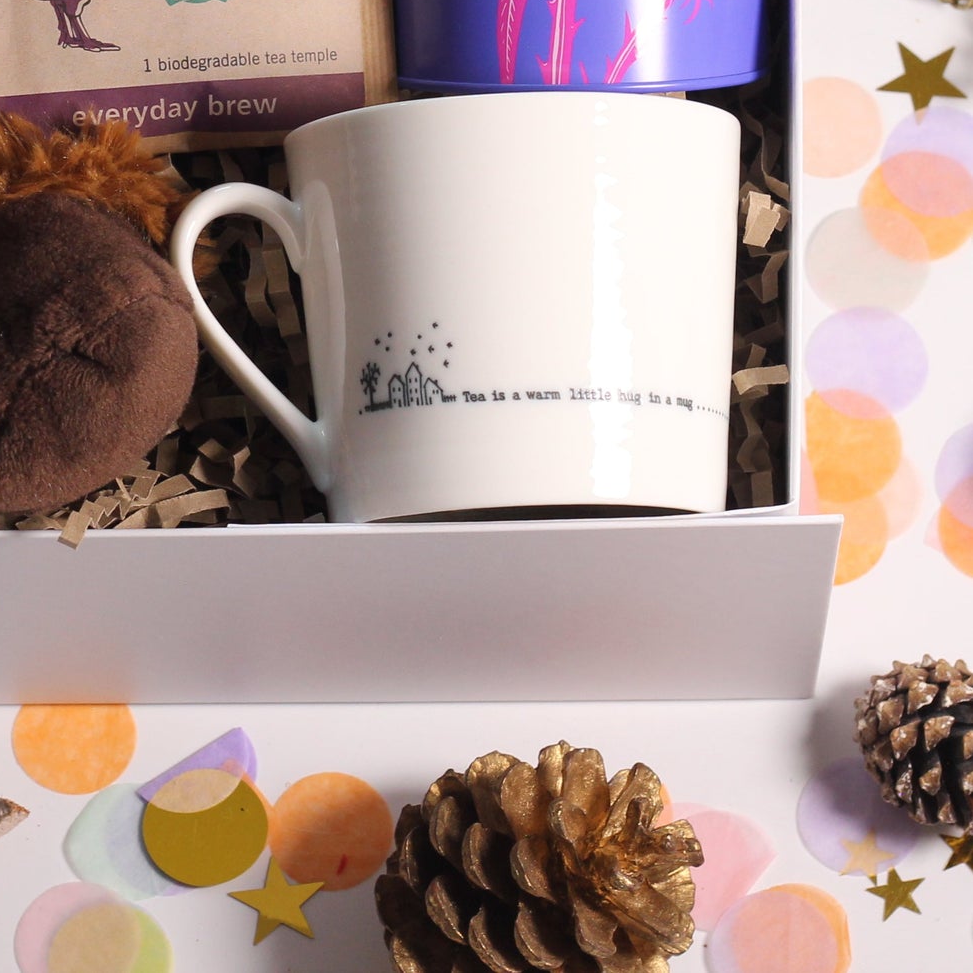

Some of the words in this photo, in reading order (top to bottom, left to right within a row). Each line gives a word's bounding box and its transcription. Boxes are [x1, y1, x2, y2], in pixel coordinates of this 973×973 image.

[143, 58, 152, 72] 1
[158, 52, 260, 72] biodegradable
[265, 53, 287, 65] tea
[291, 48, 338, 65] temple
[72, 98, 198, 128] everyday
[208, 94, 278, 116] brew
[462, 390, 486, 403] Tea
[491, 389, 505, 401] is
[512, 391, 521, 401] a
[526, 390, 561, 401] warm
[569, 387, 612, 401] little
[618, 388, 642, 405] hug
[649, 391, 661, 404] in
[665, 394, 672, 405] a
